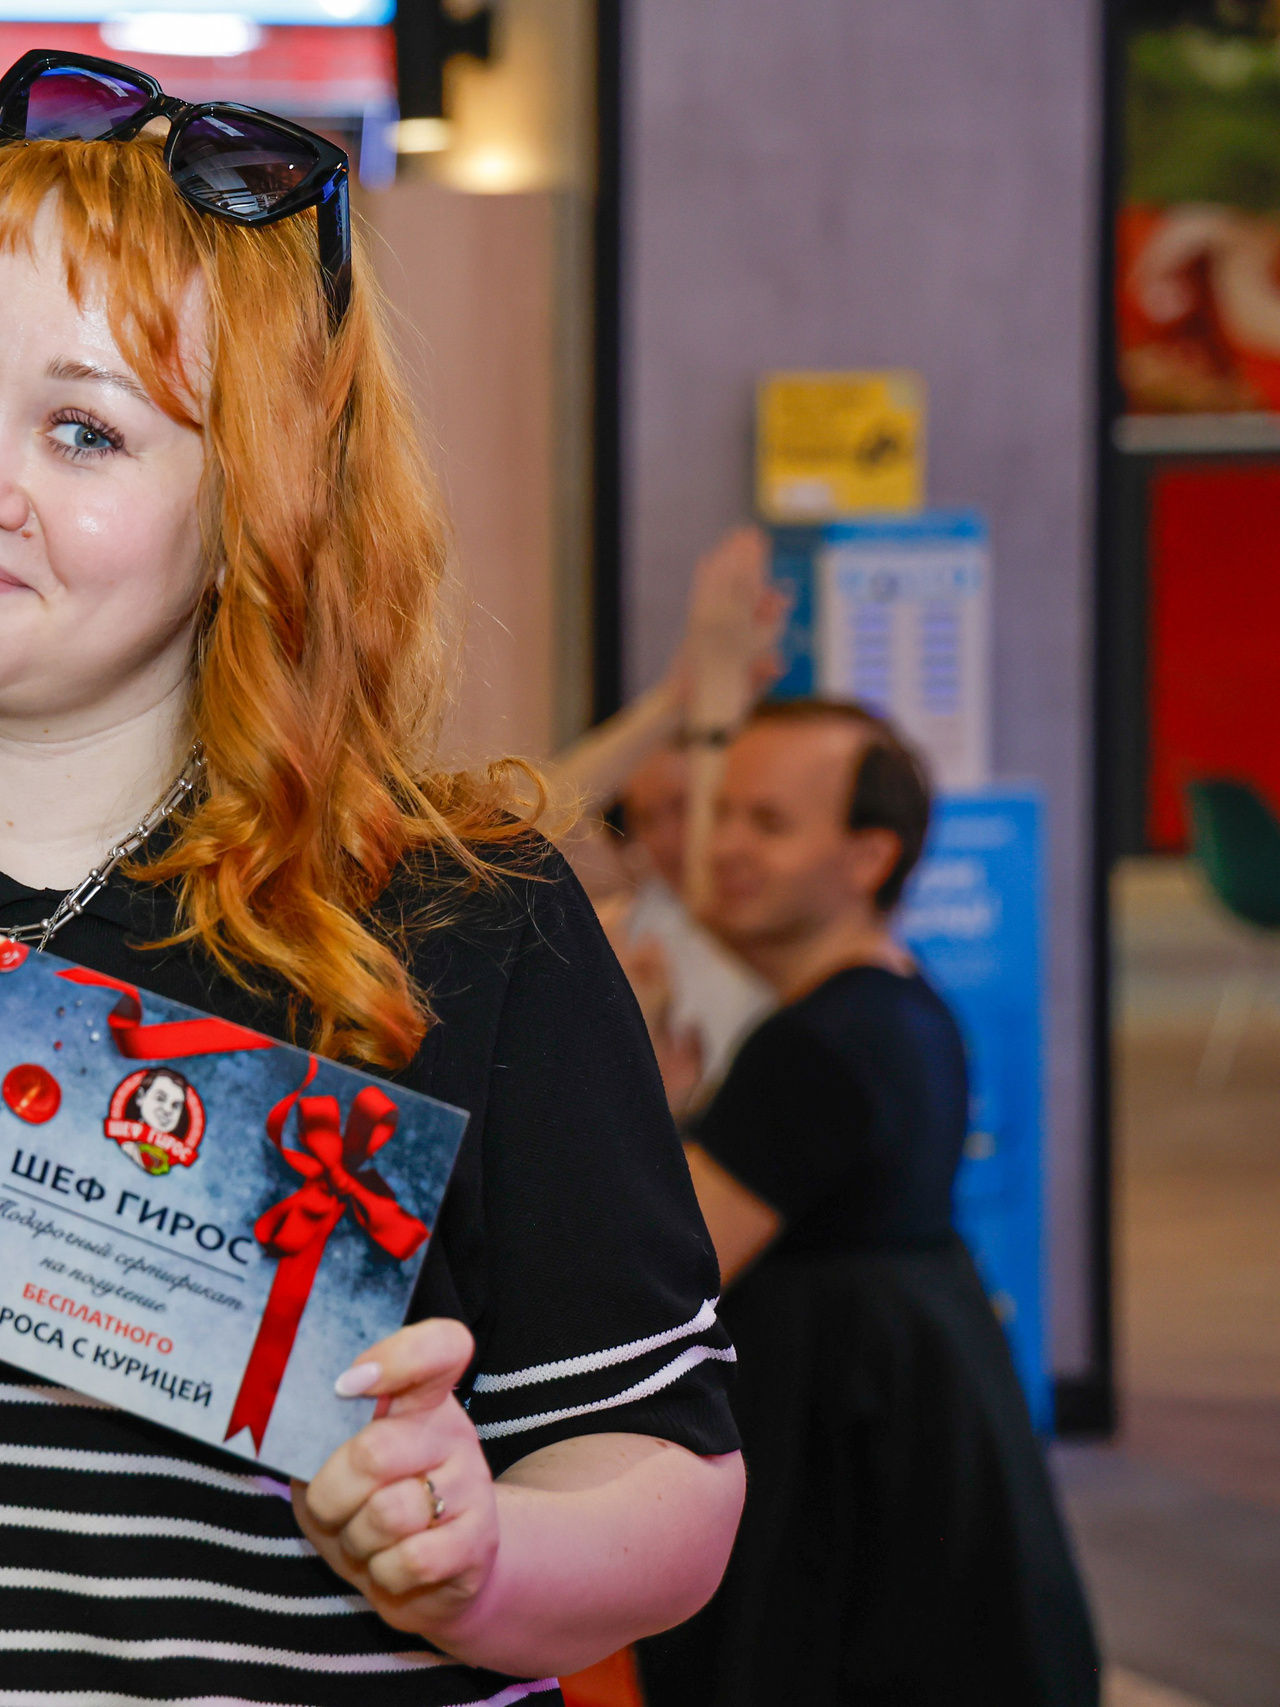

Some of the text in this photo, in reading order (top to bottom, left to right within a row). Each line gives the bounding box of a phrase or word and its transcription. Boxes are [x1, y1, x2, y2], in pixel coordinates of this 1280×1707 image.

[11, 1149, 255, 1265] ШЕФ ГИРОС
[40, 1256, 167, 1313] на получение
[114, 1253, 244, 1311] сертификат
[22, 1282, 174, 1355] БЕСПЛАТНОГО
[72, 1337, 88, 1358] С
[92, 1344, 214, 1408] КУРИЦЕЙ
